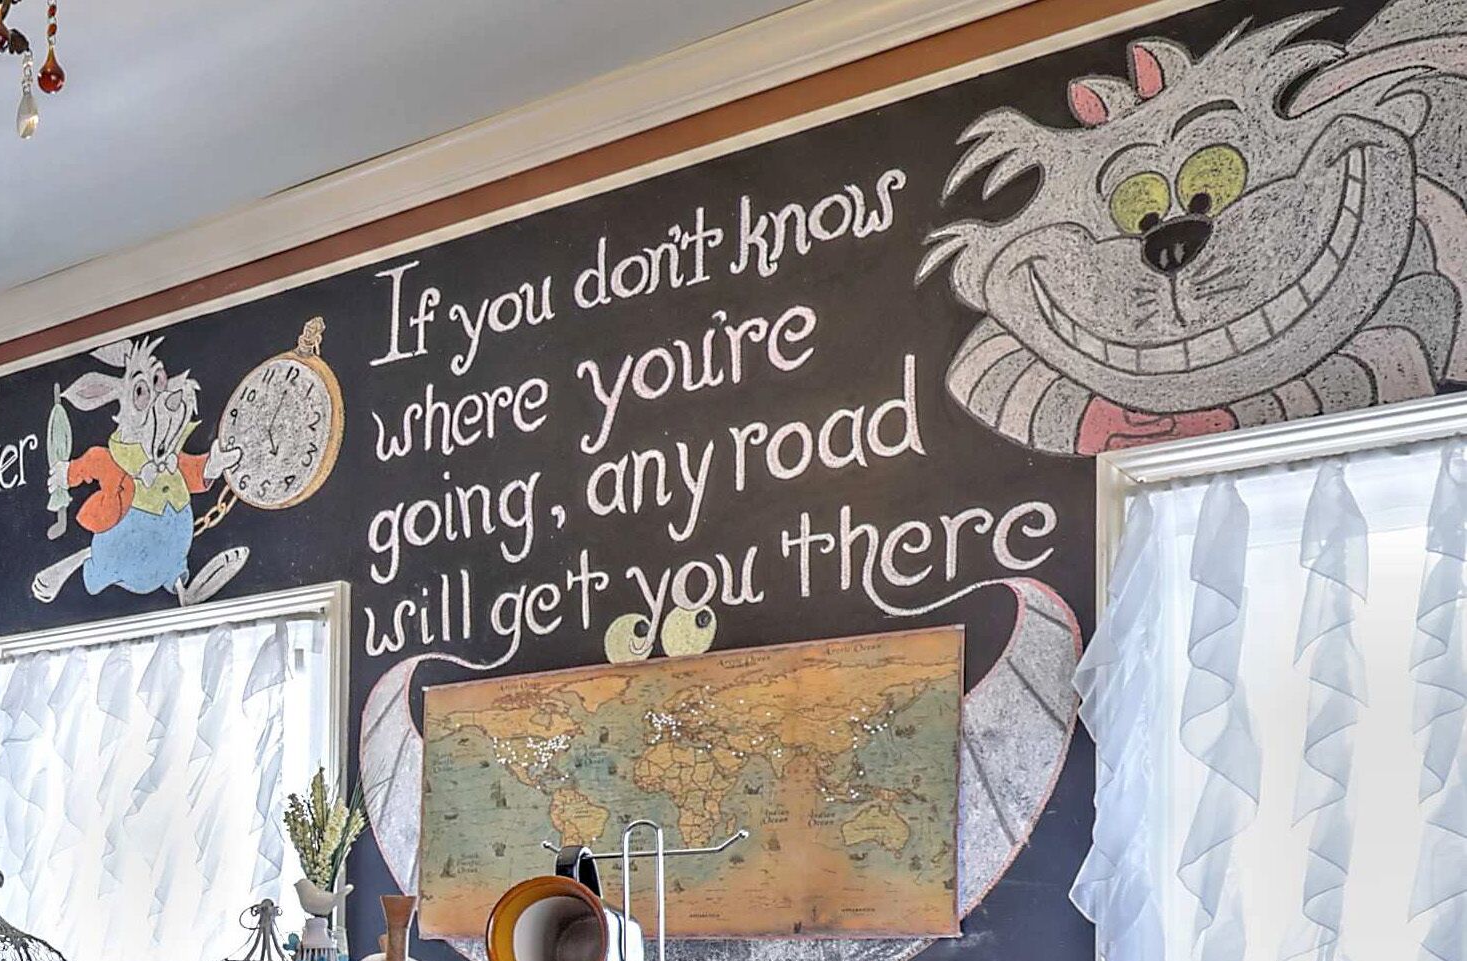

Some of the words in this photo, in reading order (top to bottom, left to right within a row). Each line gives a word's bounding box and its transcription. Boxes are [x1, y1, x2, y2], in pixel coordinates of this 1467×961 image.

[370, 261, 440, 368] If
[450, 279, 556, 375] you
[574, 205, 724, 310] don't
[730, 168, 907, 279] know
[368, 470, 565, 585] going,
[586, 439, 714, 542] any
[730, 354, 928, 492] road
[371, 376, 549, 464] where
[577, 304, 818, 456] you're
[363, 568, 471, 659] will
[491, 548, 609, 671] get
[626, 545, 764, 656] you
[782, 501, 1059, 618] there
